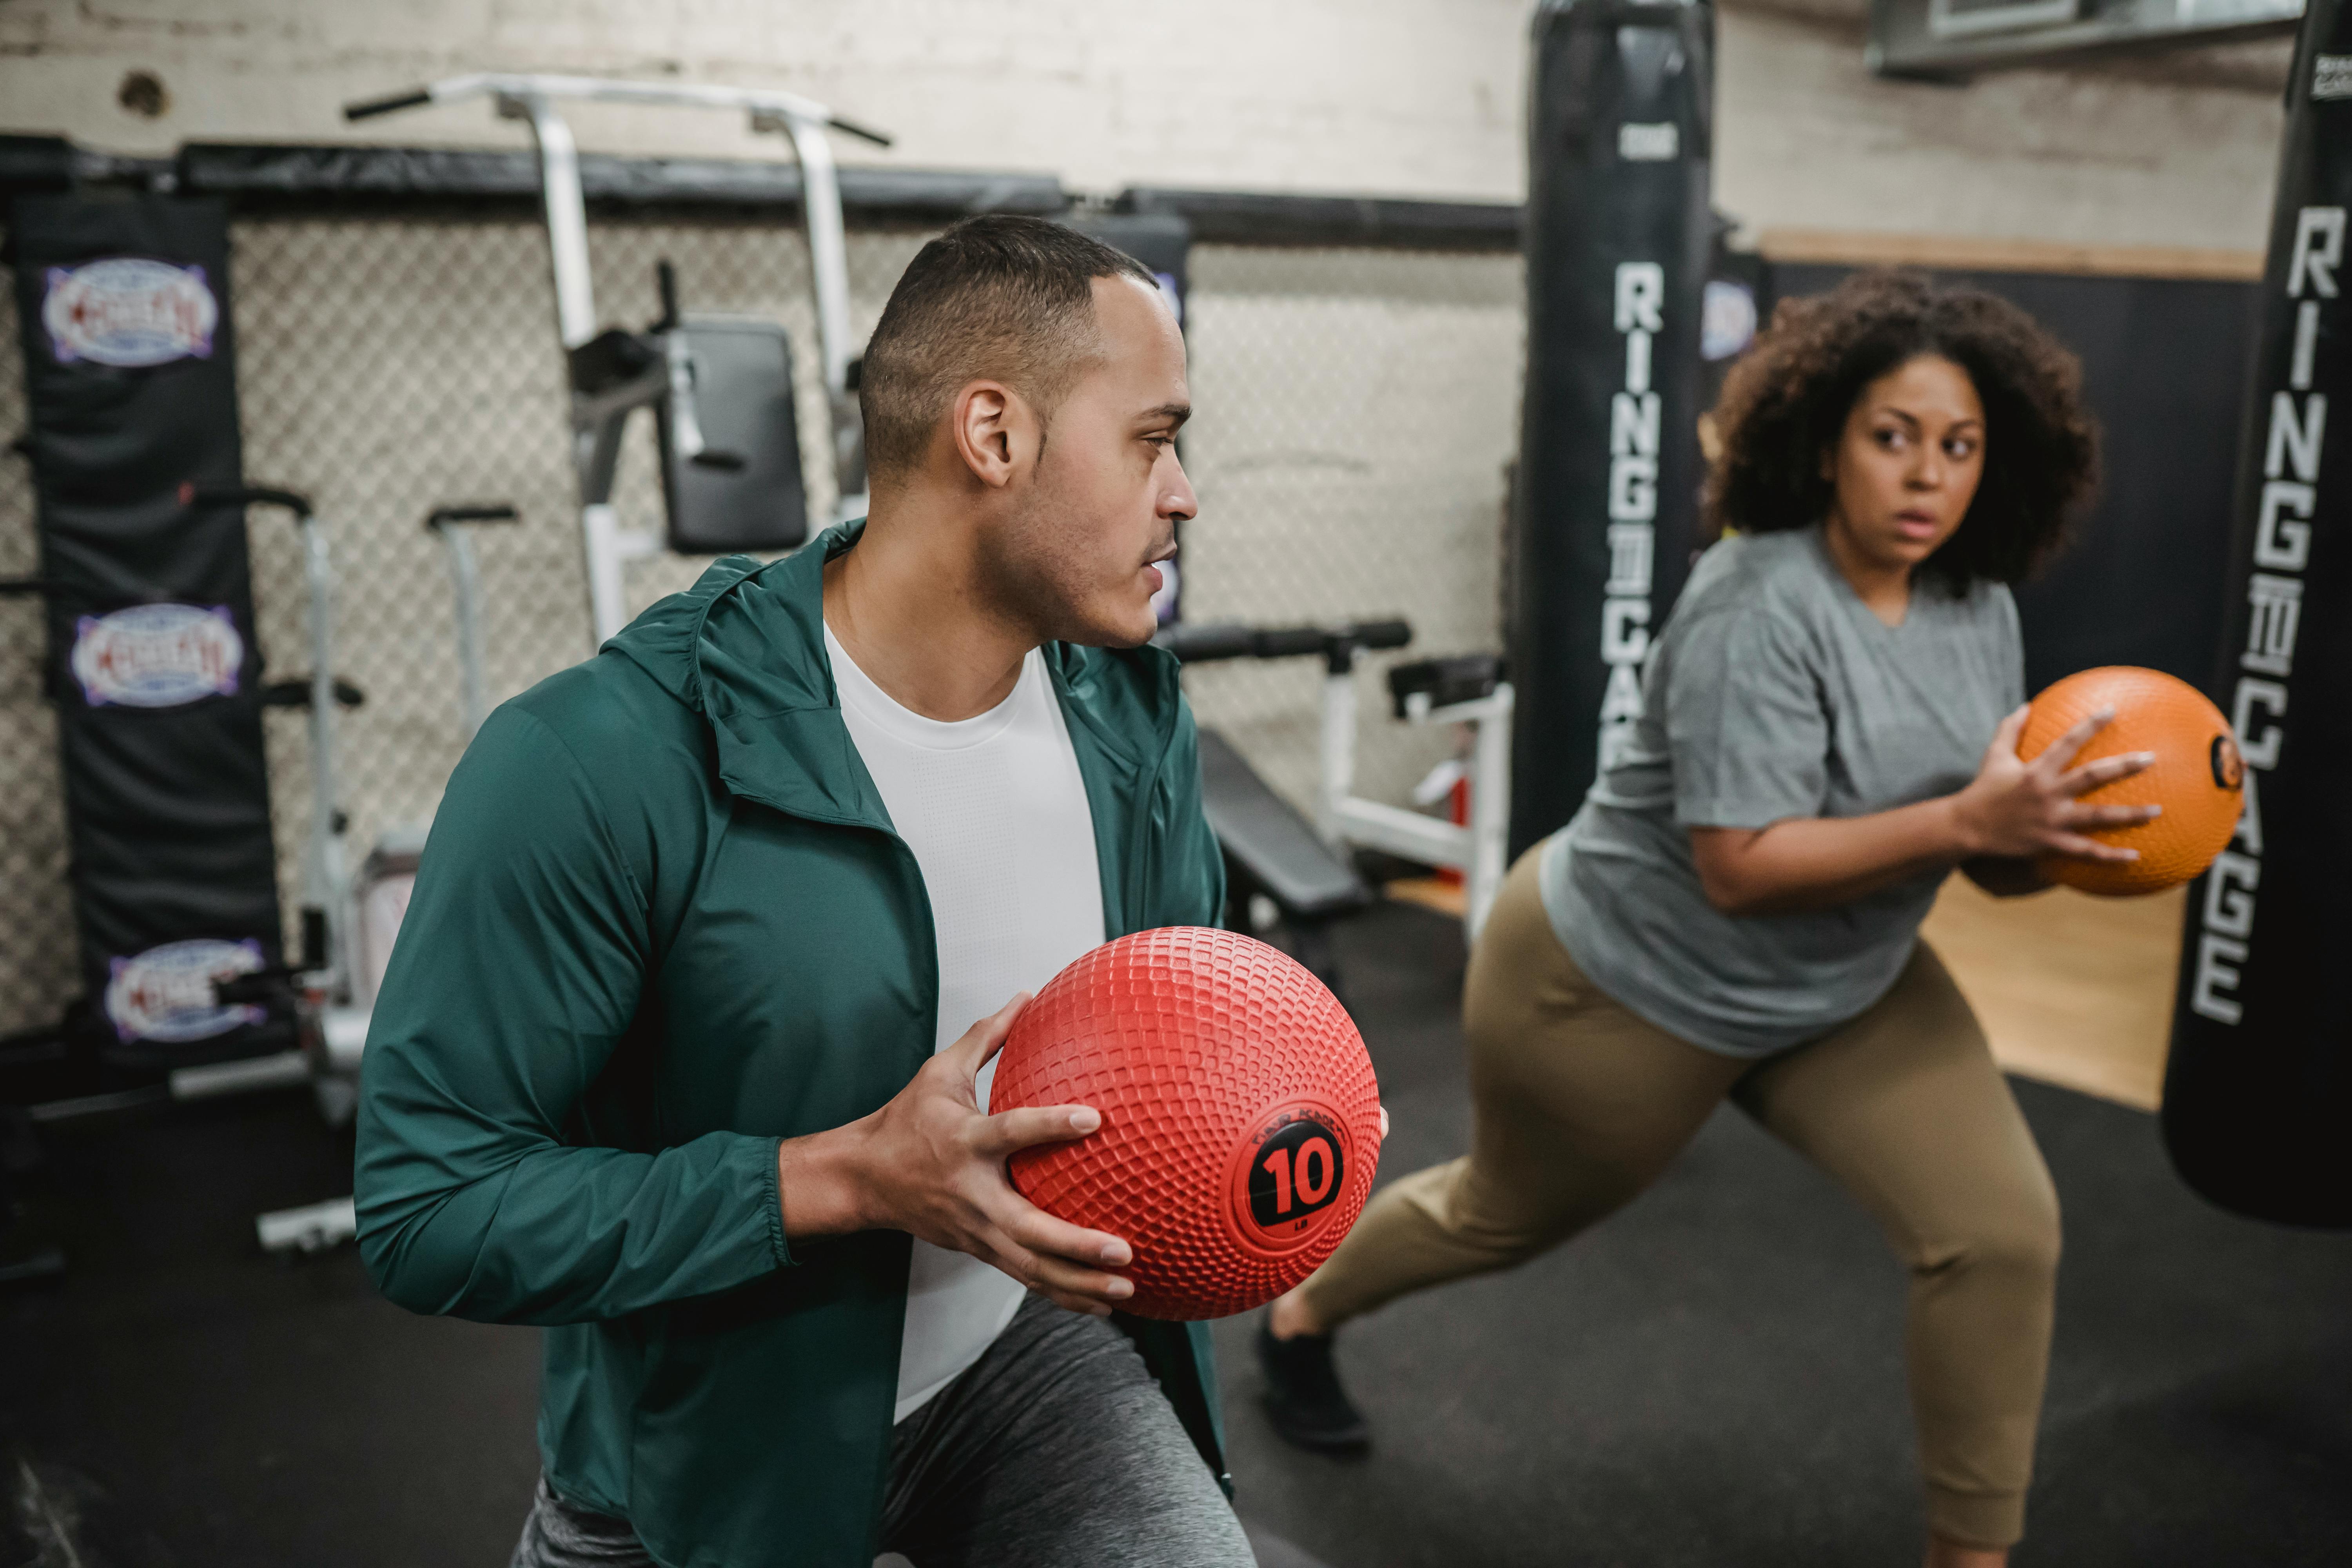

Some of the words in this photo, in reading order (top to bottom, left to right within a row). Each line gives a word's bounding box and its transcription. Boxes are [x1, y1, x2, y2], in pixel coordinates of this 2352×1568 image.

[1608, 261, 1664, 523] RING
[2251, 205, 2348, 573] RING
[1262, 1136, 1334, 1214] 10
